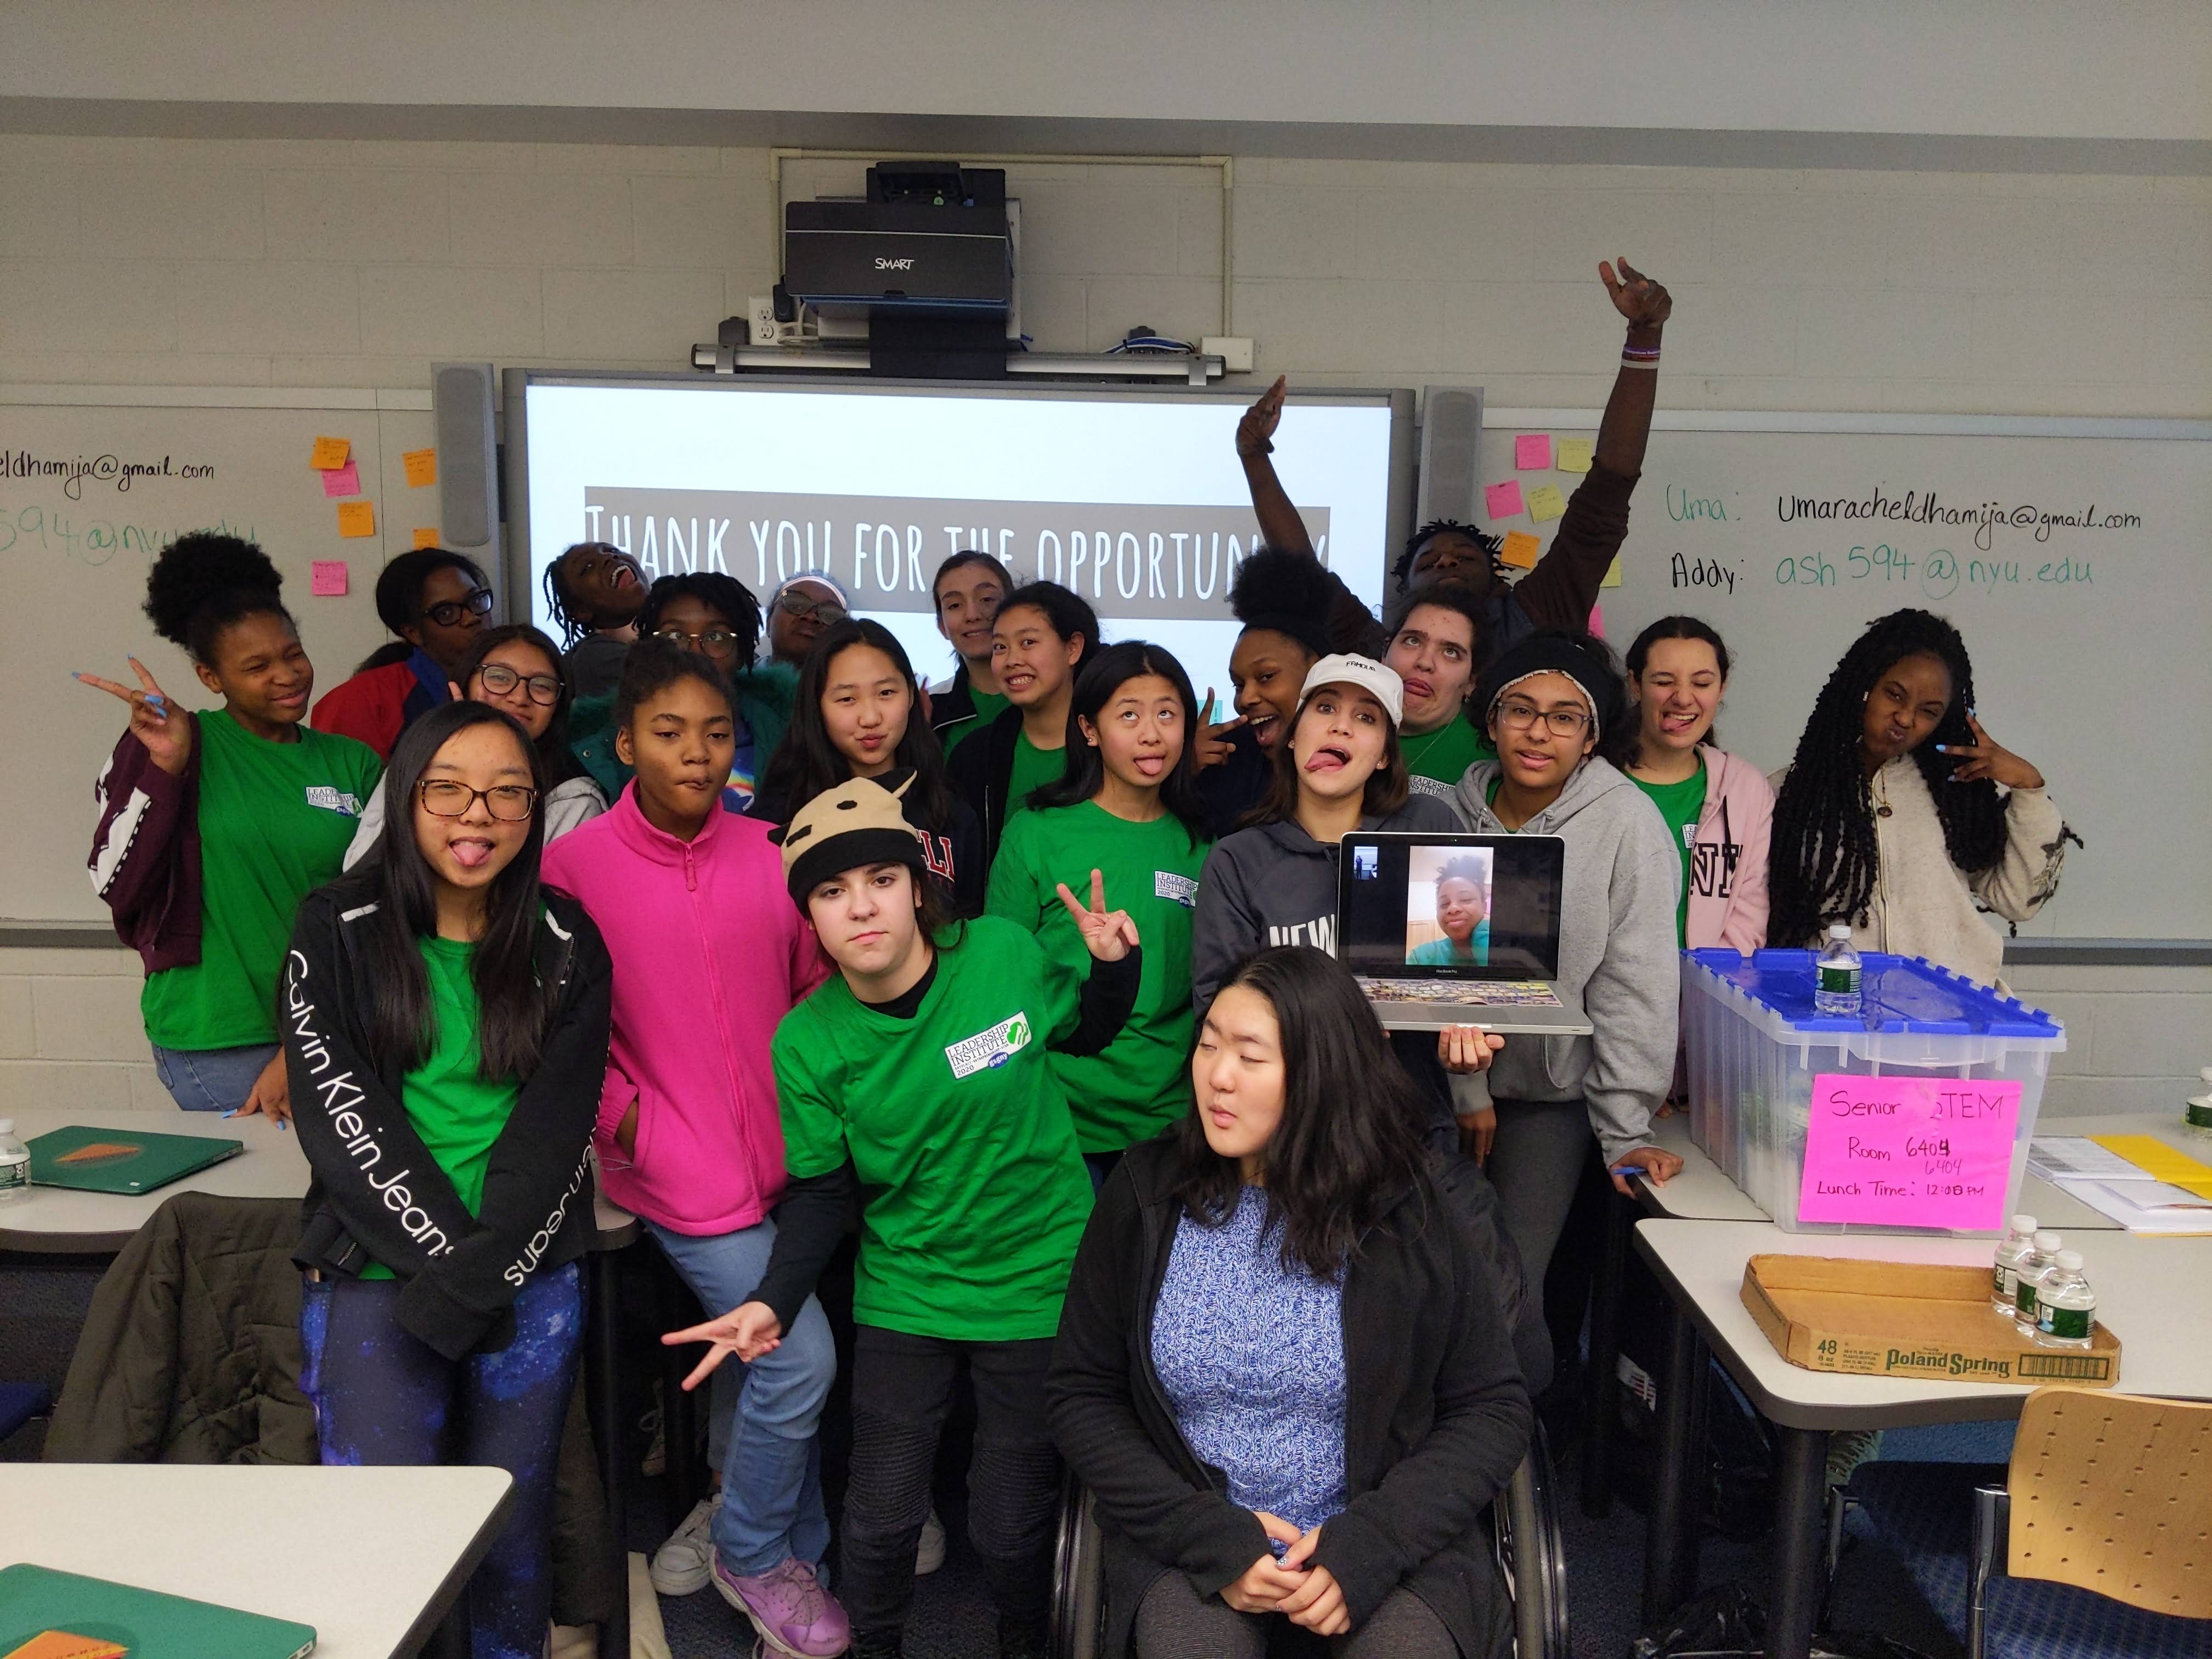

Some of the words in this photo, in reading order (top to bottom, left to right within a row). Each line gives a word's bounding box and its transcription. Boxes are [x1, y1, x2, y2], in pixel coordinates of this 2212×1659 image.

[875, 257, 915, 270] SMART
[1667, 484, 1741, 521] Uma:
[585, 506, 730, 579] THANK
[749, 520, 831, 586] YOU
[855, 523, 926, 592] FOR
[1037, 529, 1326, 600] OPPORTUN
[1672, 552, 1744, 595] Addy:
[1156, 873, 1198, 890] LEADERSHIP
[1156, 879, 1193, 896] INSTITUTE
[947, 1023, 1009, 1058] LEADERSHIP
[951, 1035, 1007, 1066] INSTITUTE
[957, 1065, 974, 1076] 2020
[290, 950, 330, 1074] Calvin
[317, 1071, 383, 1170] Klein
[369, 1169, 454, 1256] Jean
[1830, 1091, 1901, 1117] Senior
[1849, 1137, 1890, 1161] Room
[1925, 1159, 1962, 1175] 6404
[1817, 1182, 1861, 1196] Lunch
[1868, 1181, 1915, 1197] Time:
[1967, 1186, 1984, 1196] PM
[1817, 1339, 1837, 1355] 48
[1886, 1348, 1948, 1370] Poland
[1949, 1353, 2010, 1378] Spring
